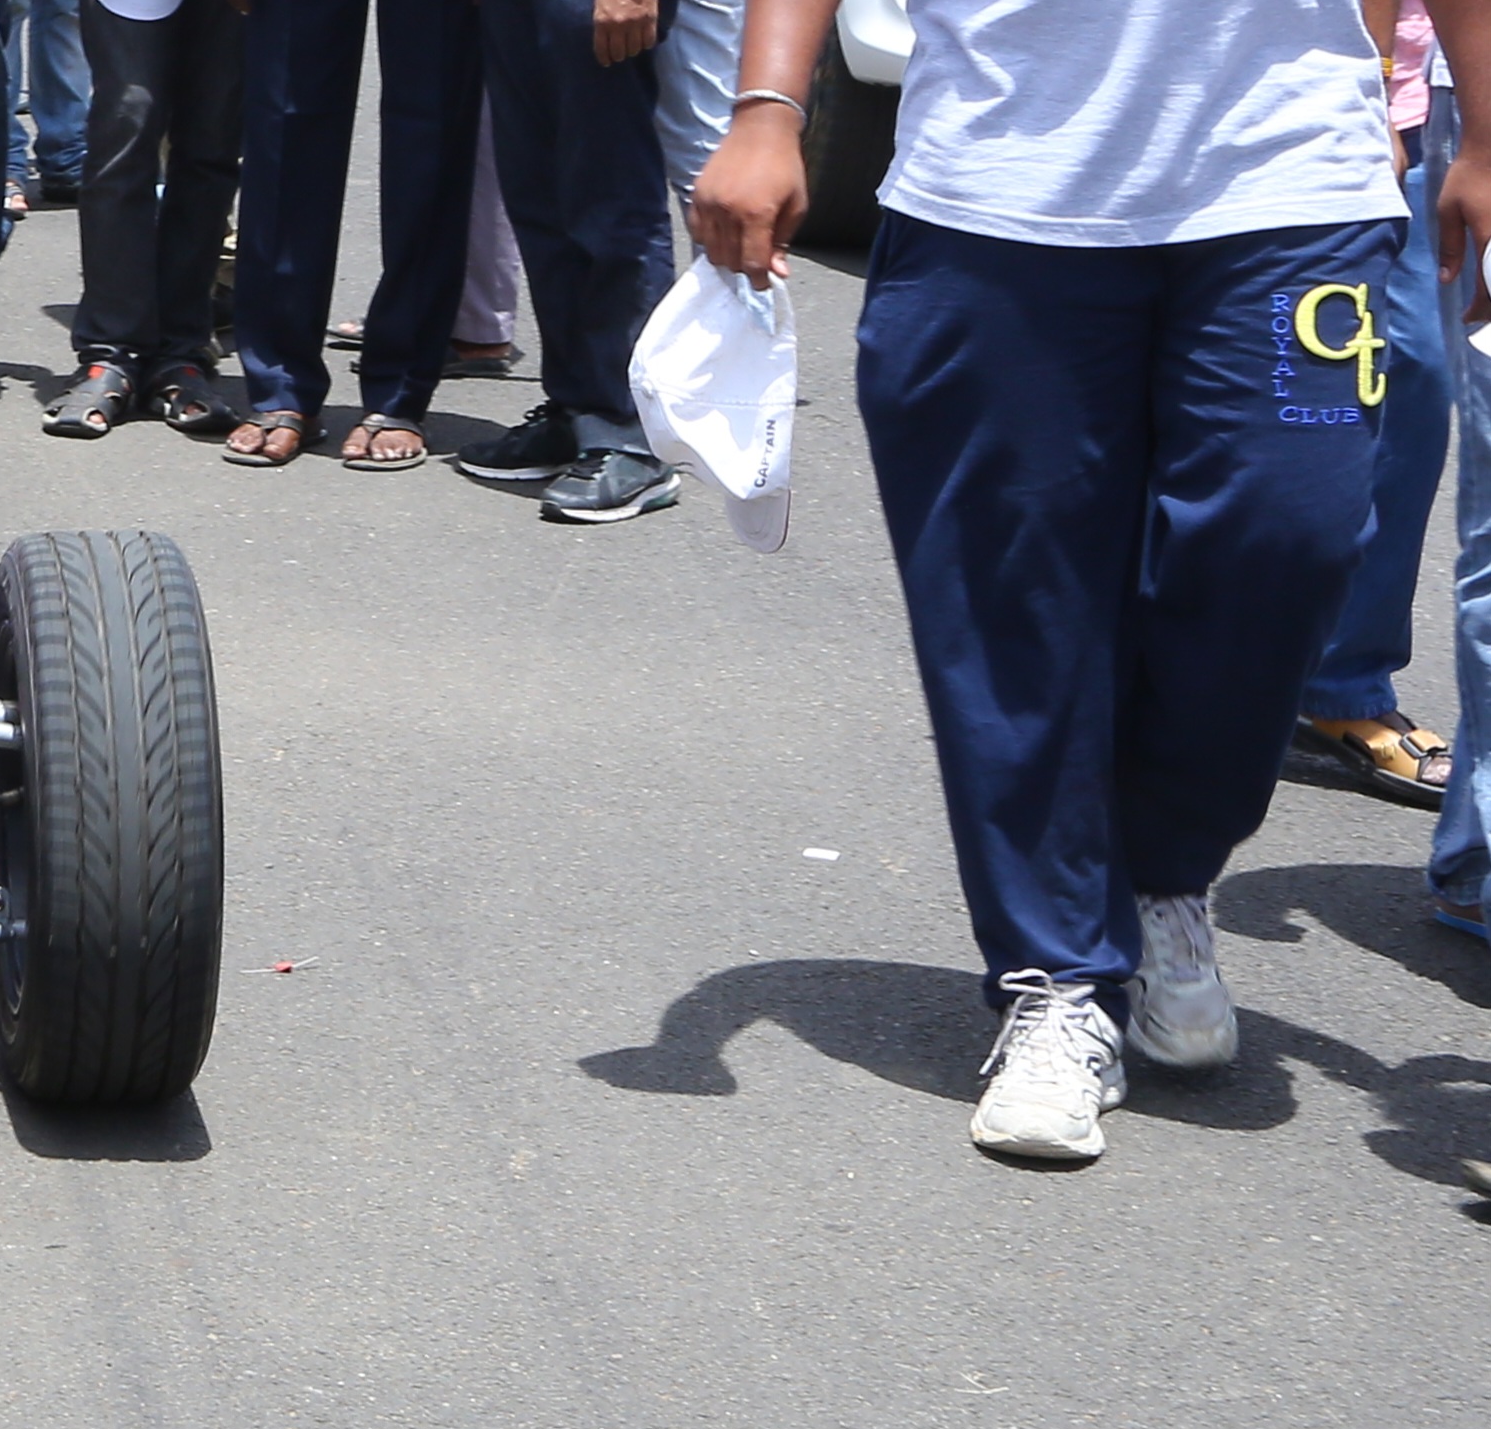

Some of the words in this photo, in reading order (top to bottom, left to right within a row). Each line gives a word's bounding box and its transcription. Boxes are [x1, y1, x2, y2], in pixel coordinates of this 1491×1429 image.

[1271, 294, 1296, 398] ROYAL
[1279, 406, 1360, 424] CLUB
[754, 419, 776, 488] CAPTAIN
